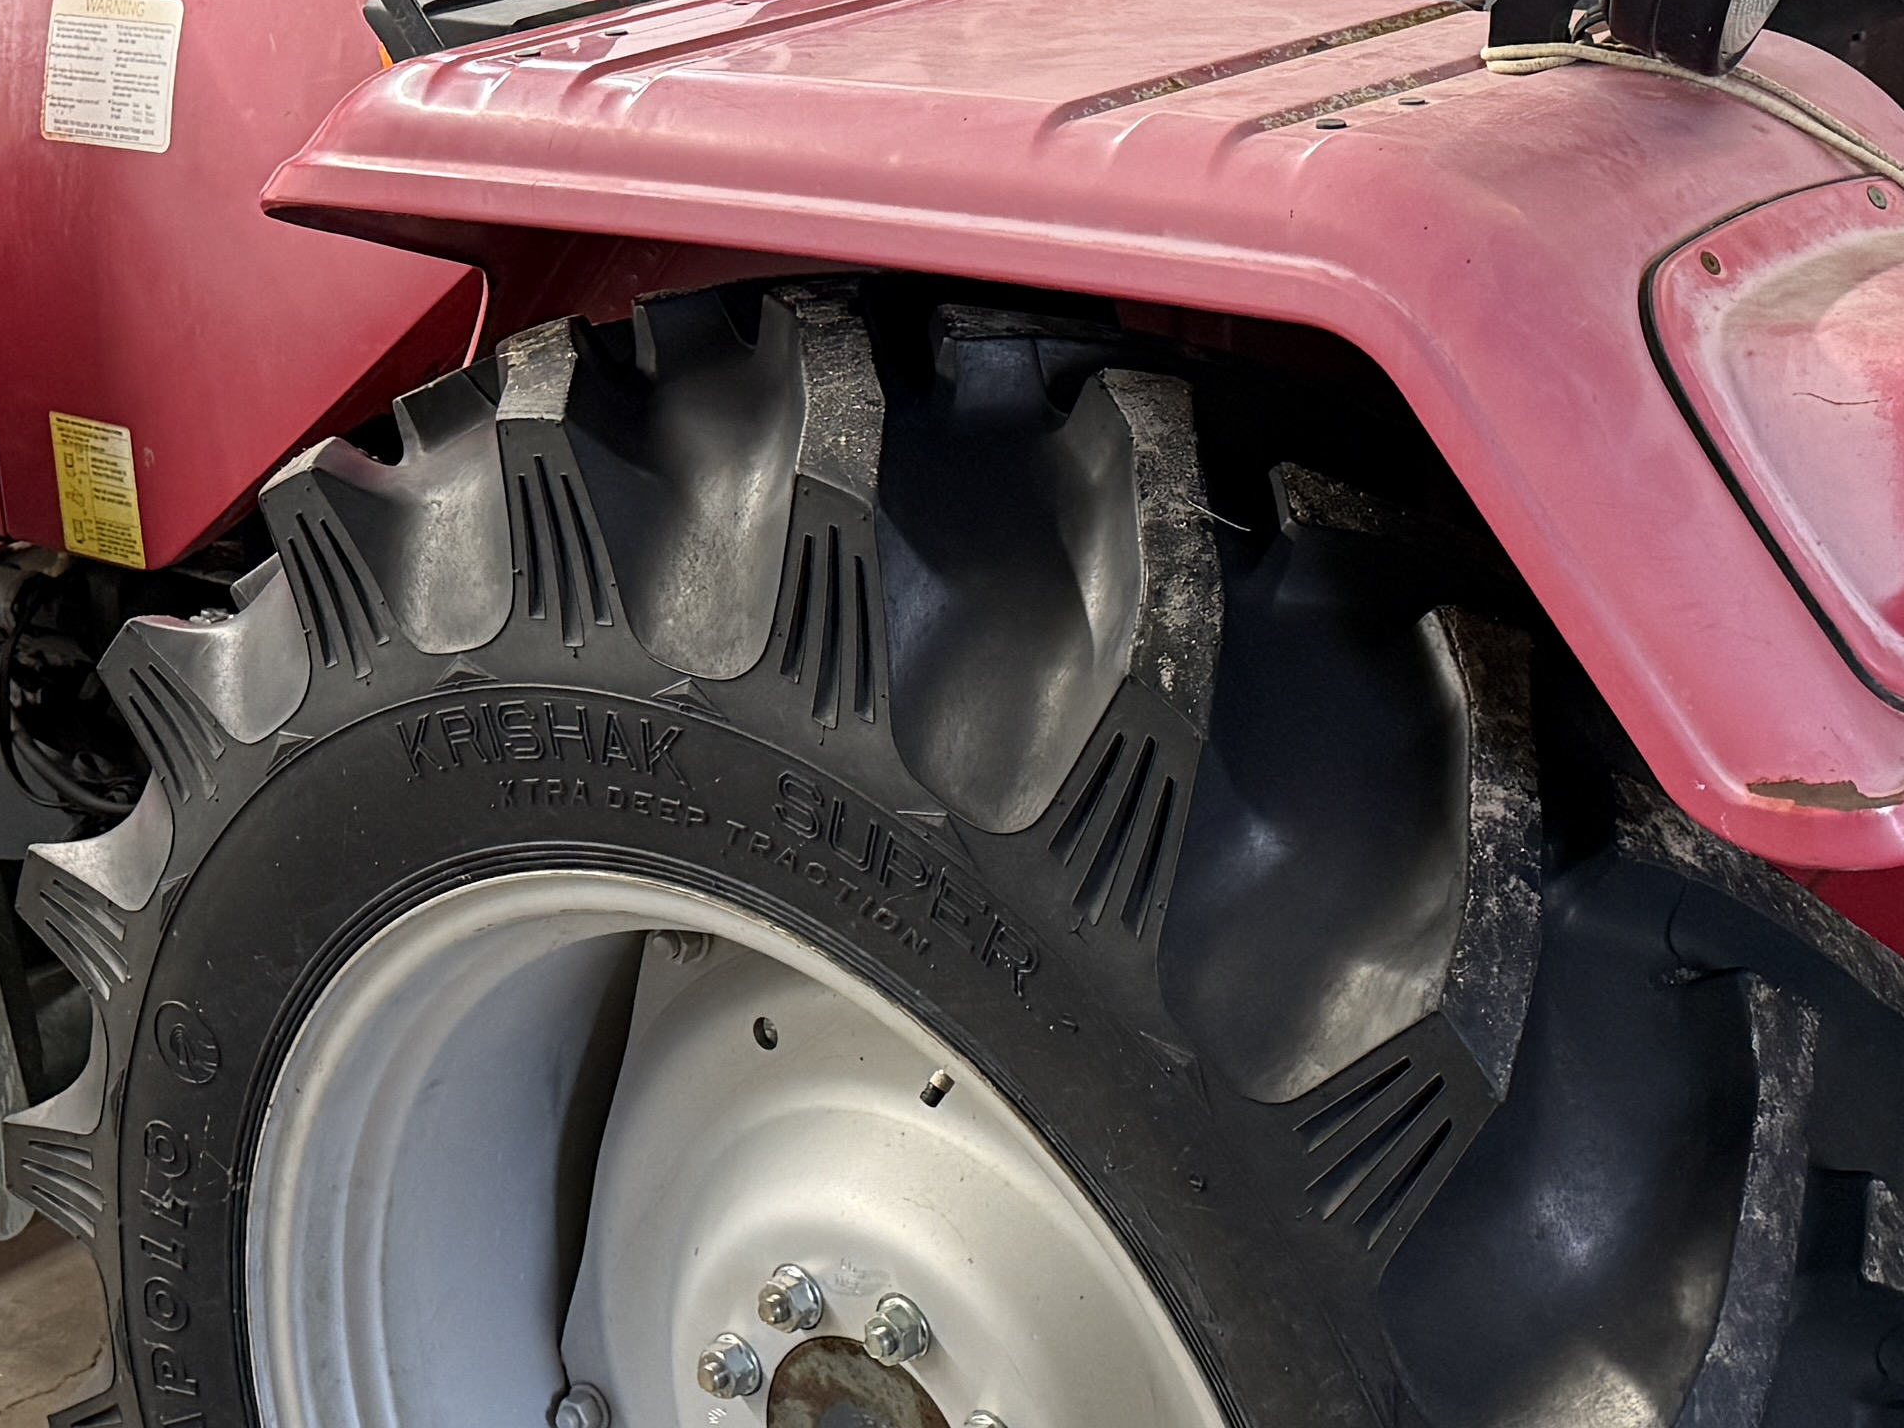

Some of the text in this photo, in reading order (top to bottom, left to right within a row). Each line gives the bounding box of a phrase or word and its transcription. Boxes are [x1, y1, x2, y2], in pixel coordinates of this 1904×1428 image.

[394, 699, 1042, 997] KRISHAK SUPER
[497, 776, 932, 958] XTRA DEEP TRACTION
